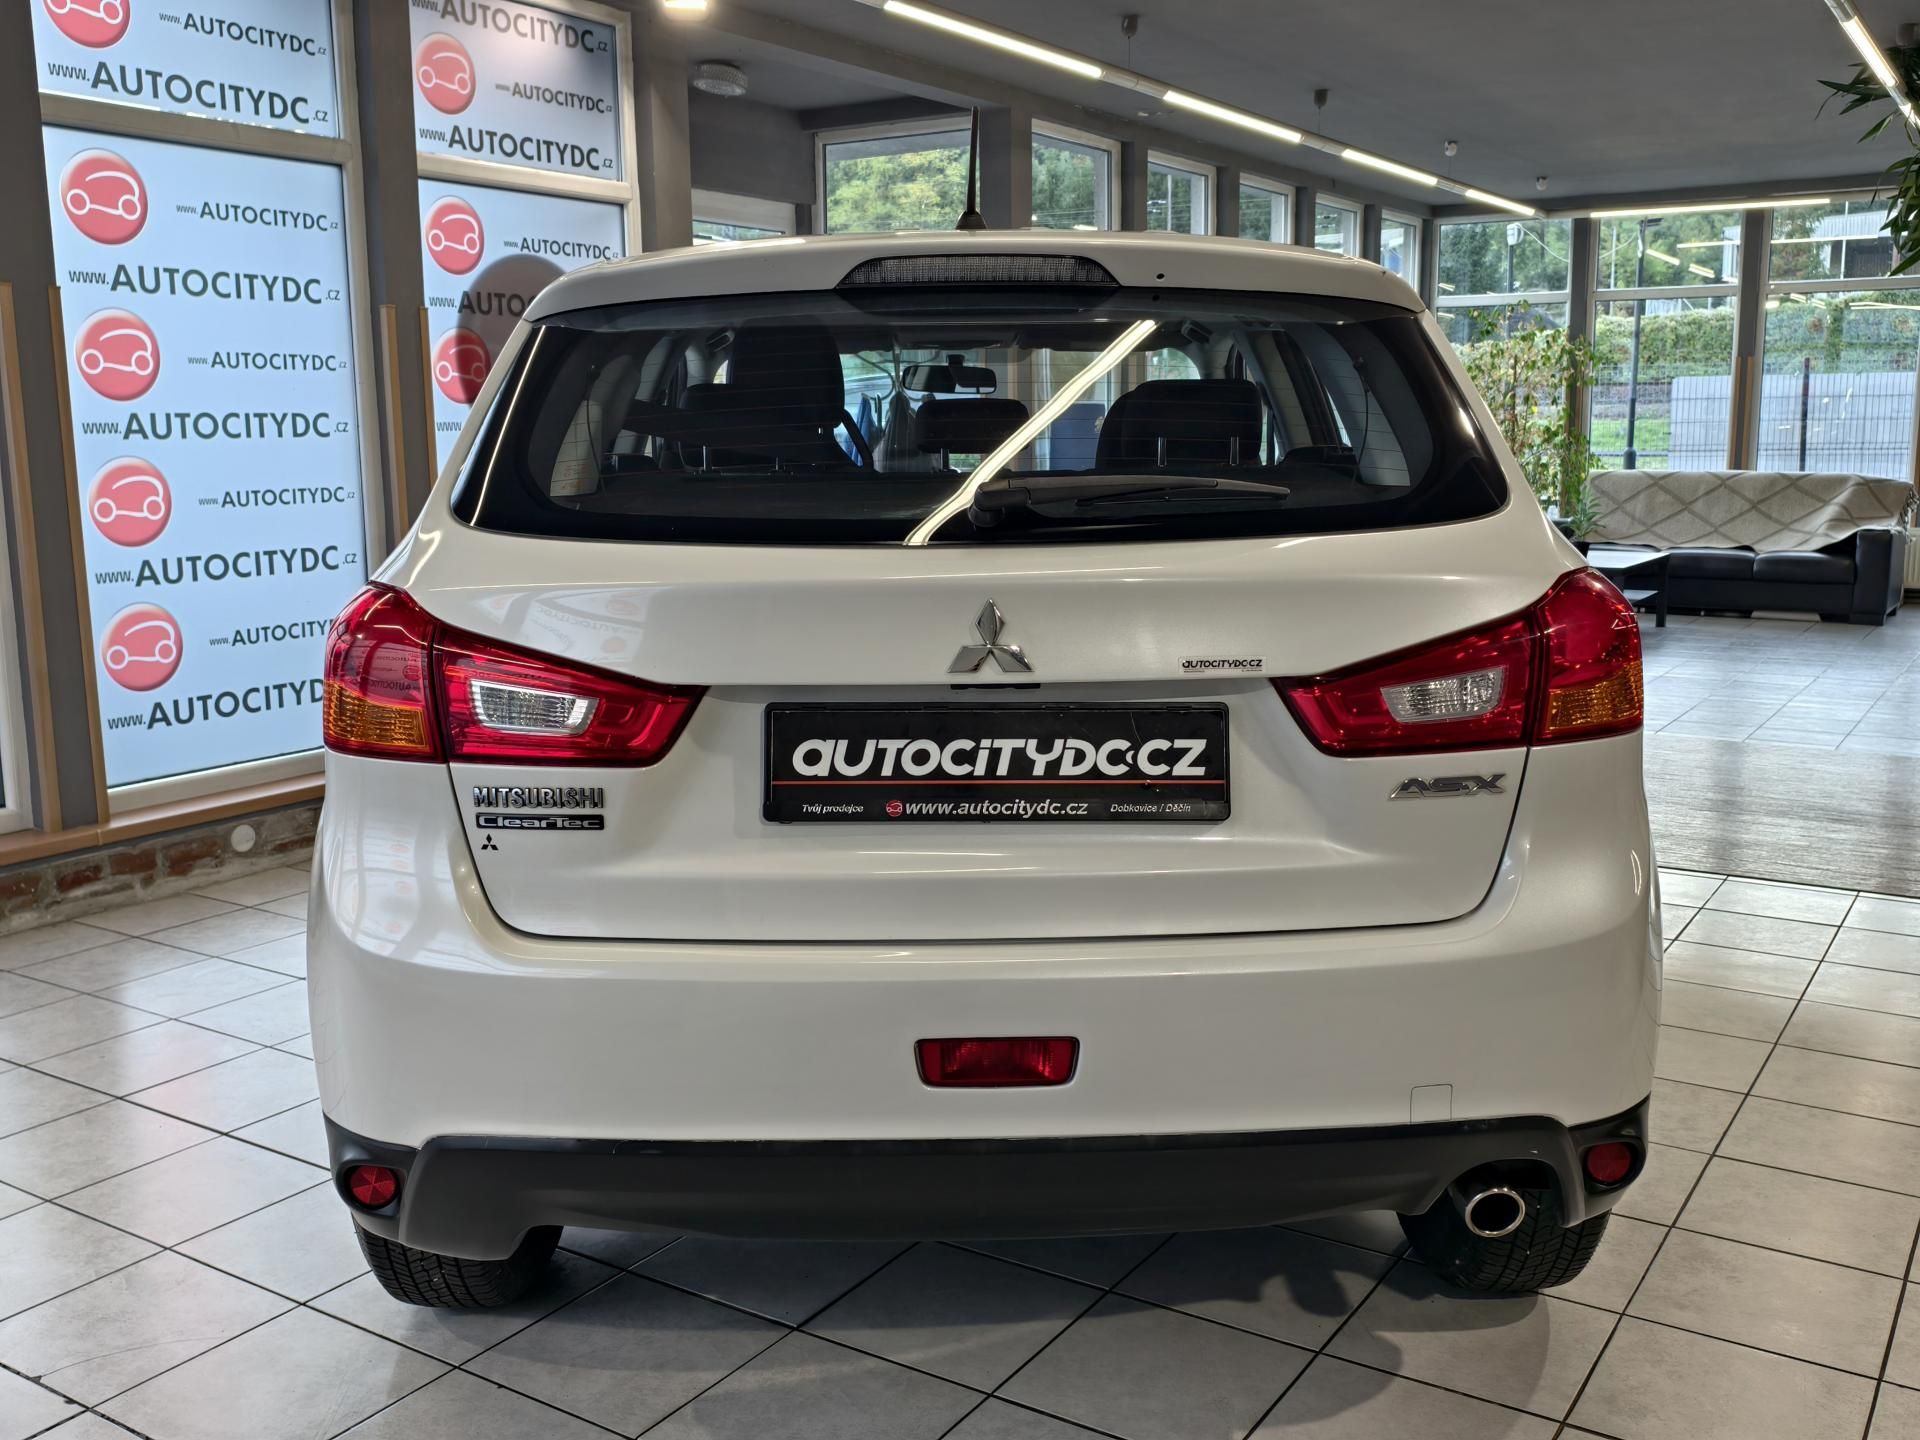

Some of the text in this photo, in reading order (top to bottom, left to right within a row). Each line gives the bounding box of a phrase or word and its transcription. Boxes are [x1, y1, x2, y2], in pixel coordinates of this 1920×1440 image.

[48, 61, 329, 124] www.AUTOCITYDC.cz
[419, 125, 614, 170] www.AUTOCITYDC.cz
[68, 264, 341, 304] www.AUTOCITYDC.cz
[82, 412, 349, 440] www.AUTOCITYDC.cz
[95, 545, 358, 587] www.AUTOCITYDC.cz
[473, 786, 605, 809] MITSUBISHI
[1389, 773, 1507, 799] ASX
[823, 803, 864, 814] prodejce
[905, 799, 1089, 819] www.autocitydc.cz
[1110, 803, 1158, 813] Dobkovice
[478, 815, 601, 828] ClearTec
